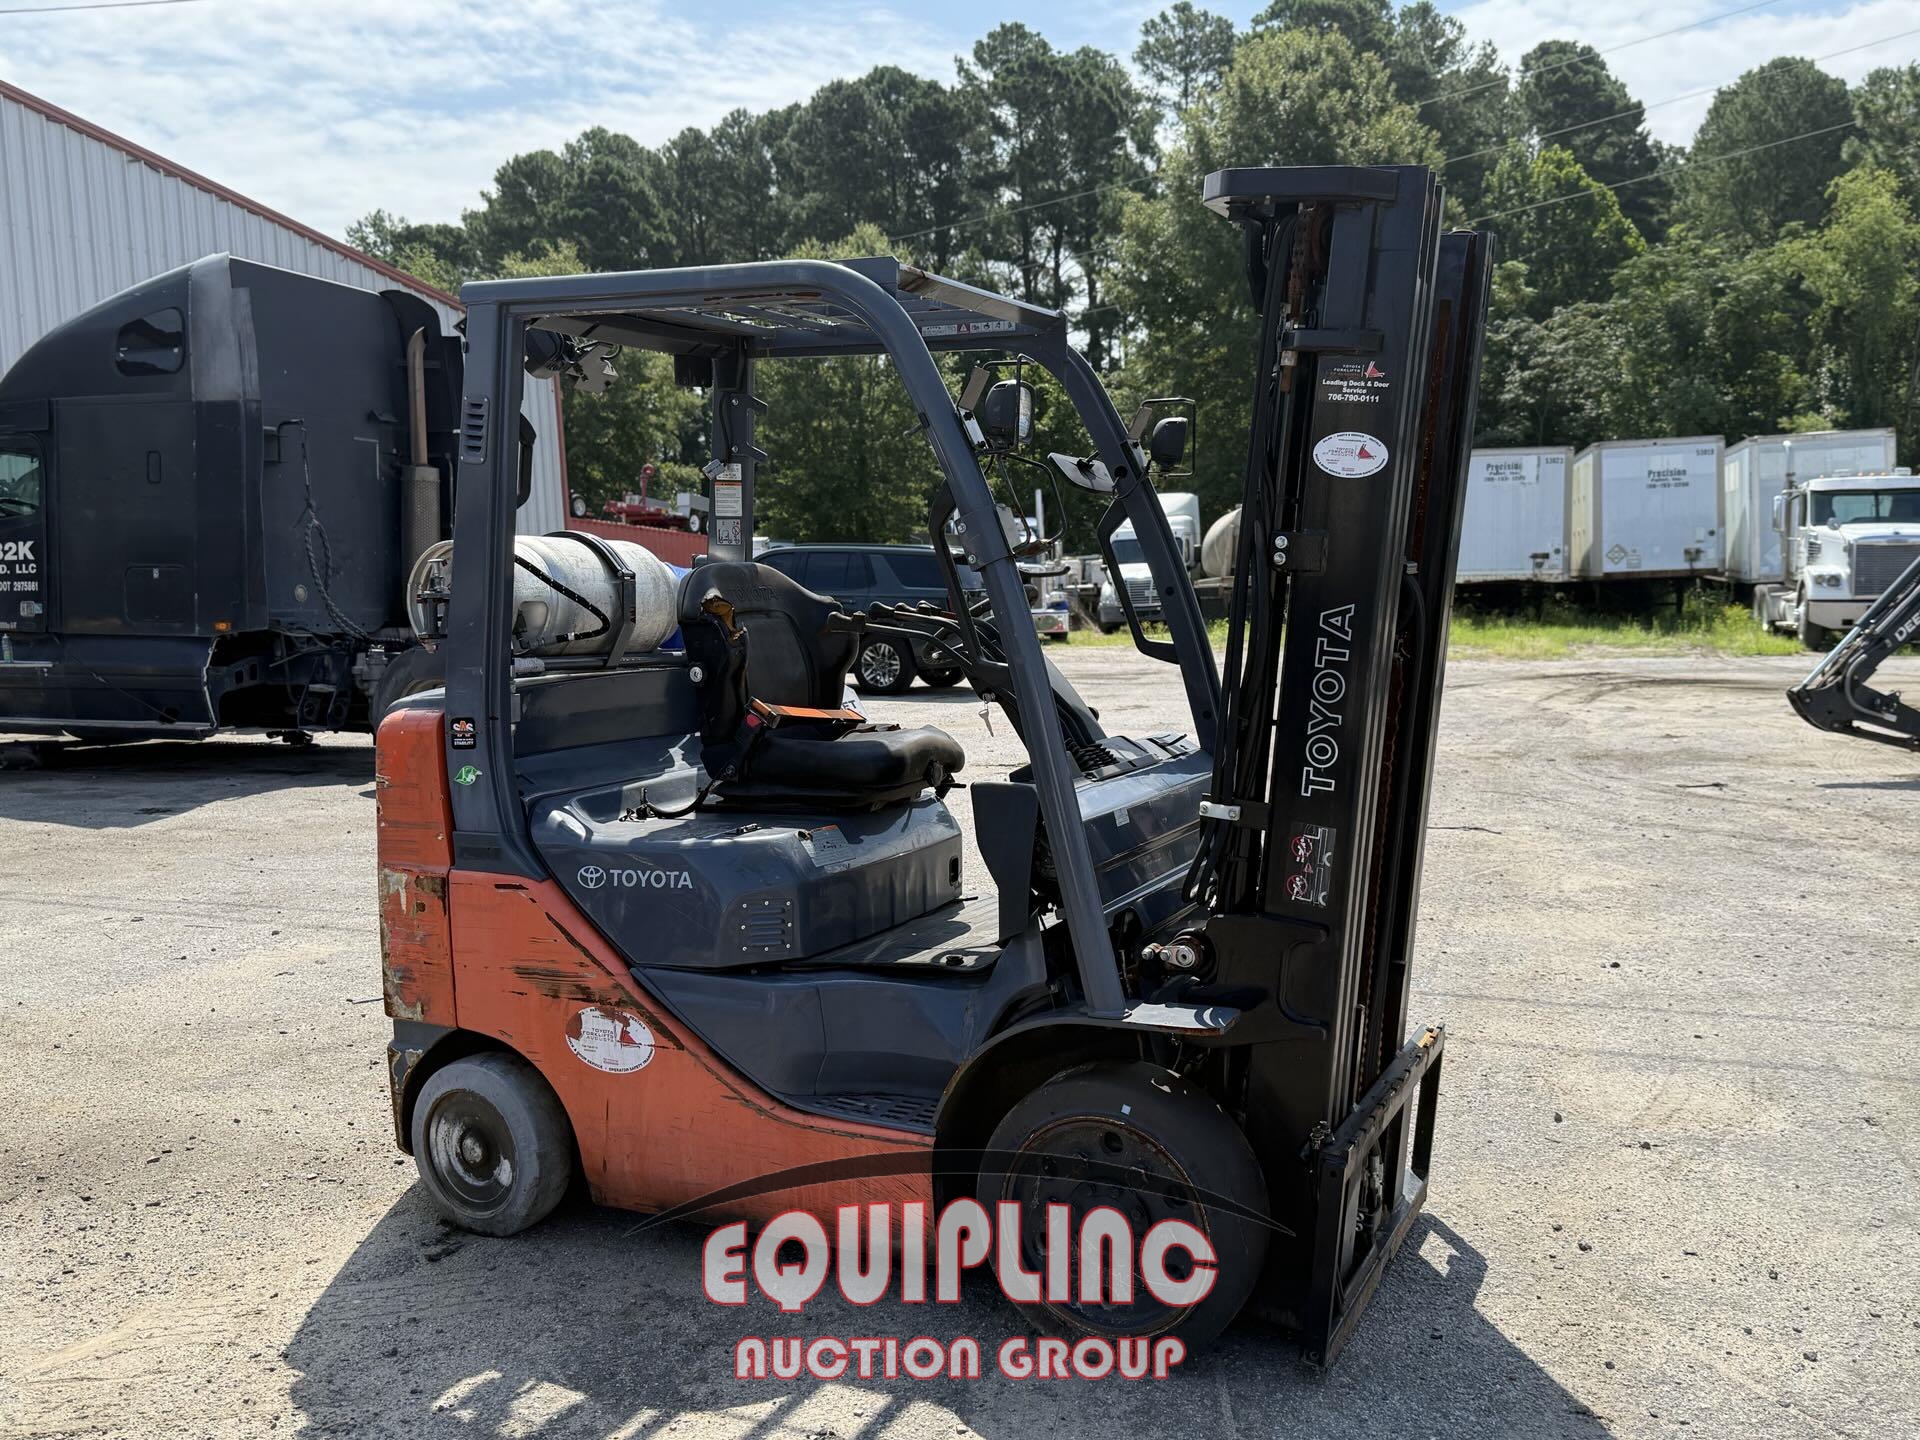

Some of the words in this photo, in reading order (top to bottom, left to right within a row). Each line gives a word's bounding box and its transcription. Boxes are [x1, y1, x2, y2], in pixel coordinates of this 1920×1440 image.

[1322, 378, 1348, 387] Loading
[1328, 393, 1380, 403] 706-790-0111
[1648, 468, 1686, 478] Precision
[16, 563, 37, 574] LLC
[1894, 609, 1920, 642] DEE
[1301, 603, 1355, 797] TOYOTA
[610, 869, 693, 889] TOYOTA
